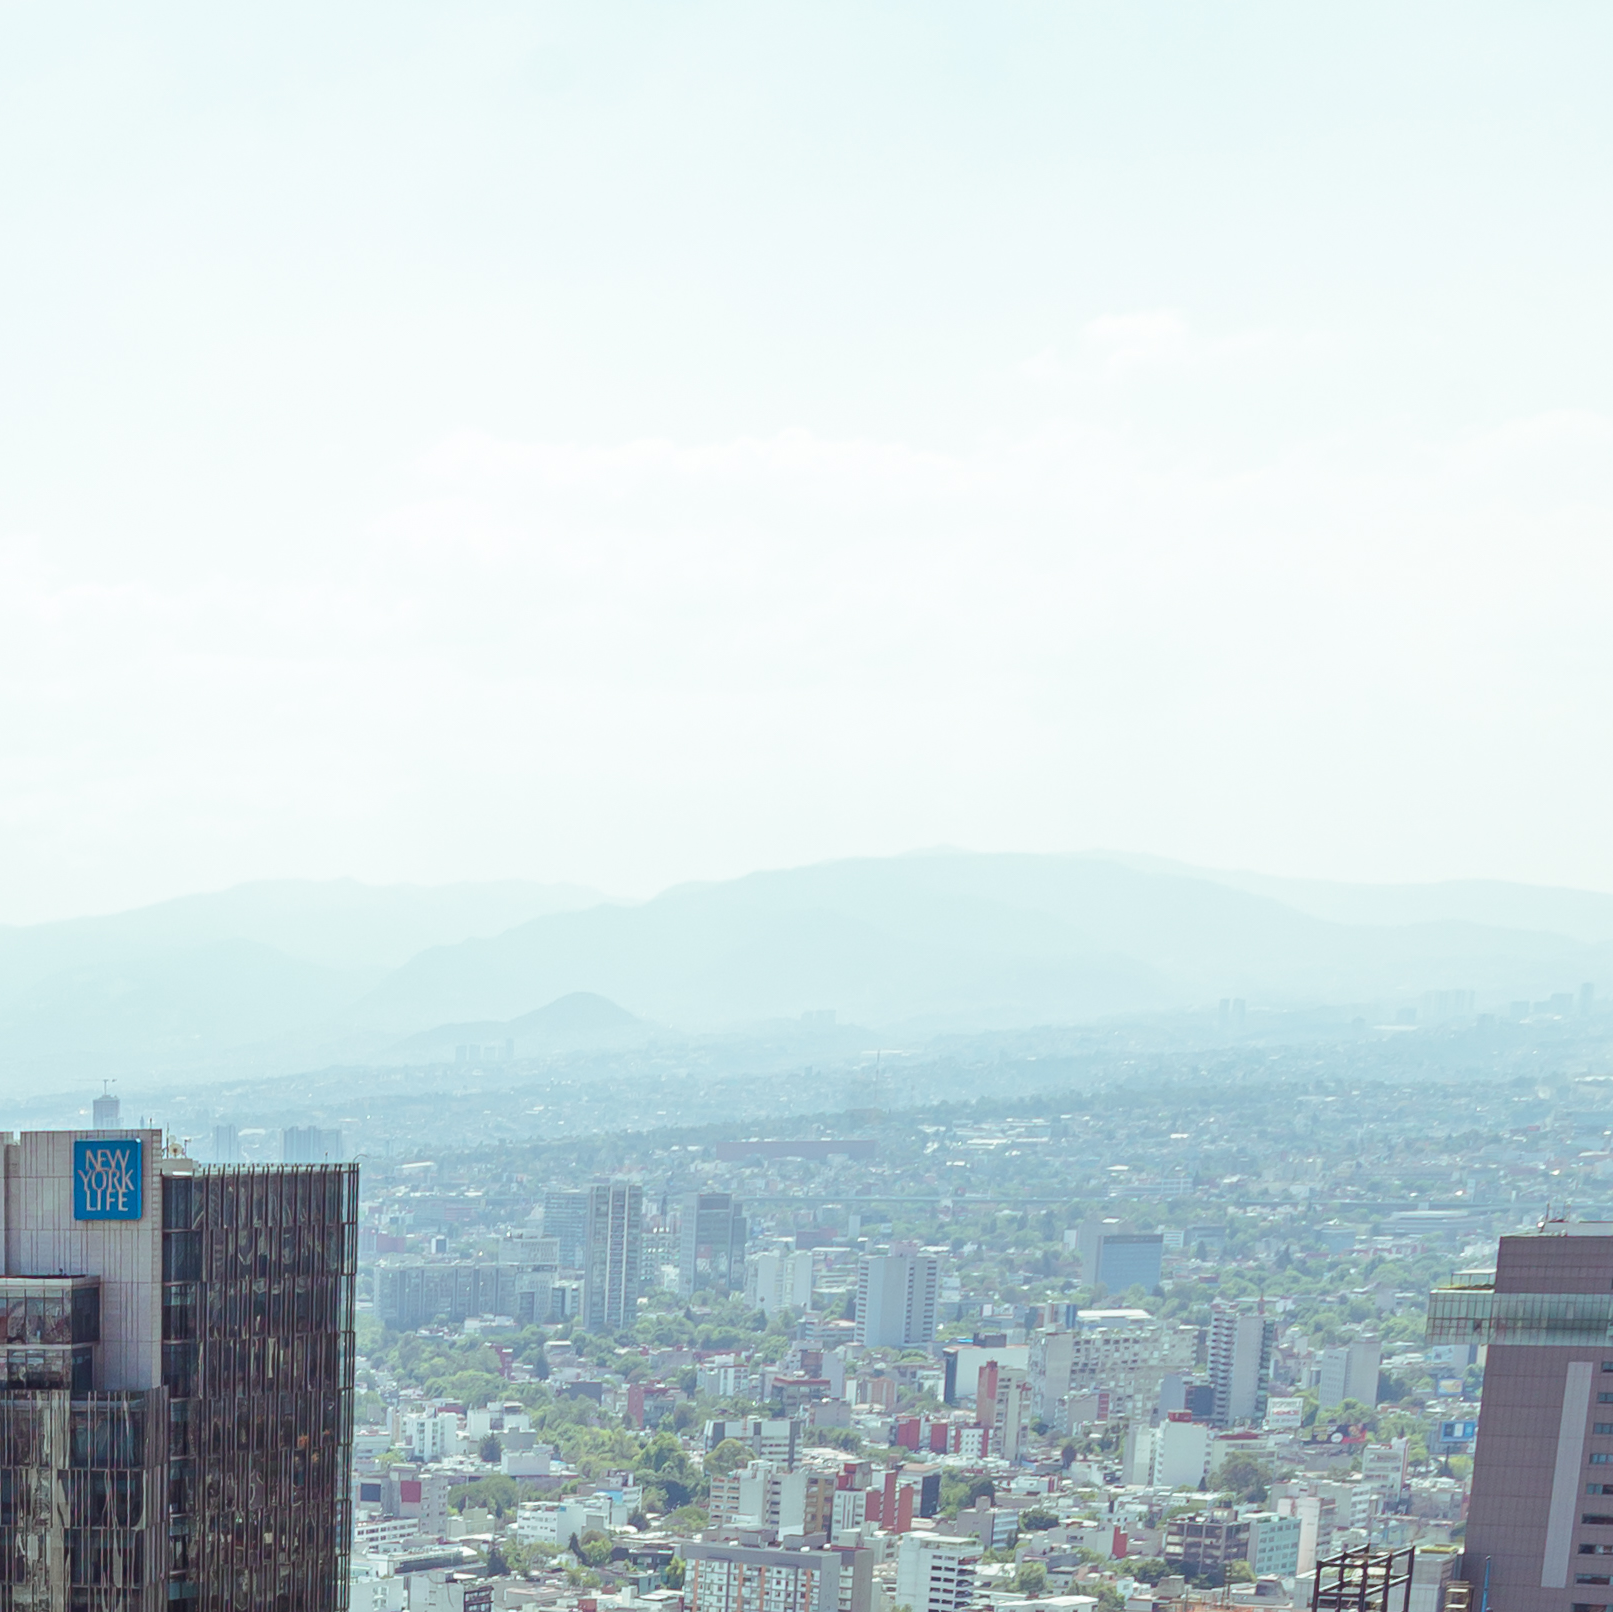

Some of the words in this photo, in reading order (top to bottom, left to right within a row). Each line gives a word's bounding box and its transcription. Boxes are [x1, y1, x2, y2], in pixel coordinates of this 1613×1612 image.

[85, 1149, 130, 1171] NEW
[77, 1169, 135, 1191] YORK
[86, 1189, 129, 1211] LIFE
